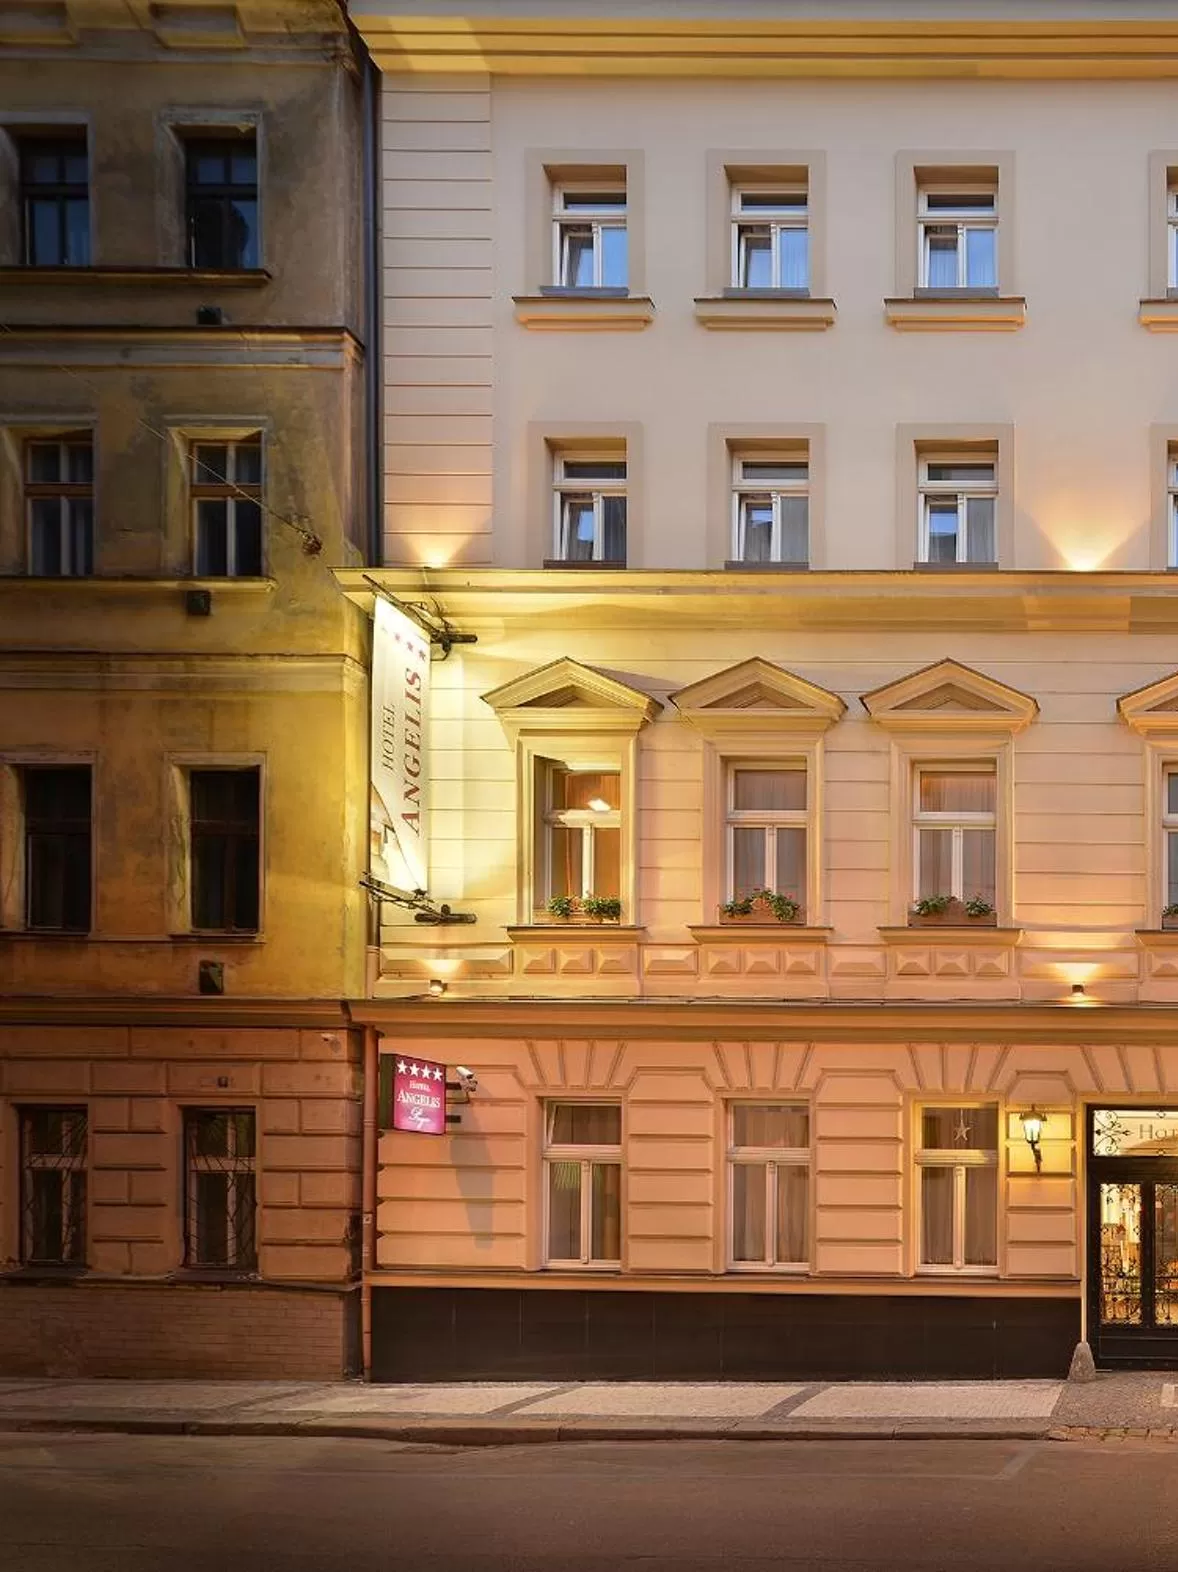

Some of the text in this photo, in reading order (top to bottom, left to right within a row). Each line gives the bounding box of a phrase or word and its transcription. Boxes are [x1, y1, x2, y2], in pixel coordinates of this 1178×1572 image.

[381, 704, 396, 772] HOTEL
[401, 667, 422, 838] ANGELIS
[397, 1089, 440, 1108] ANGELIS
